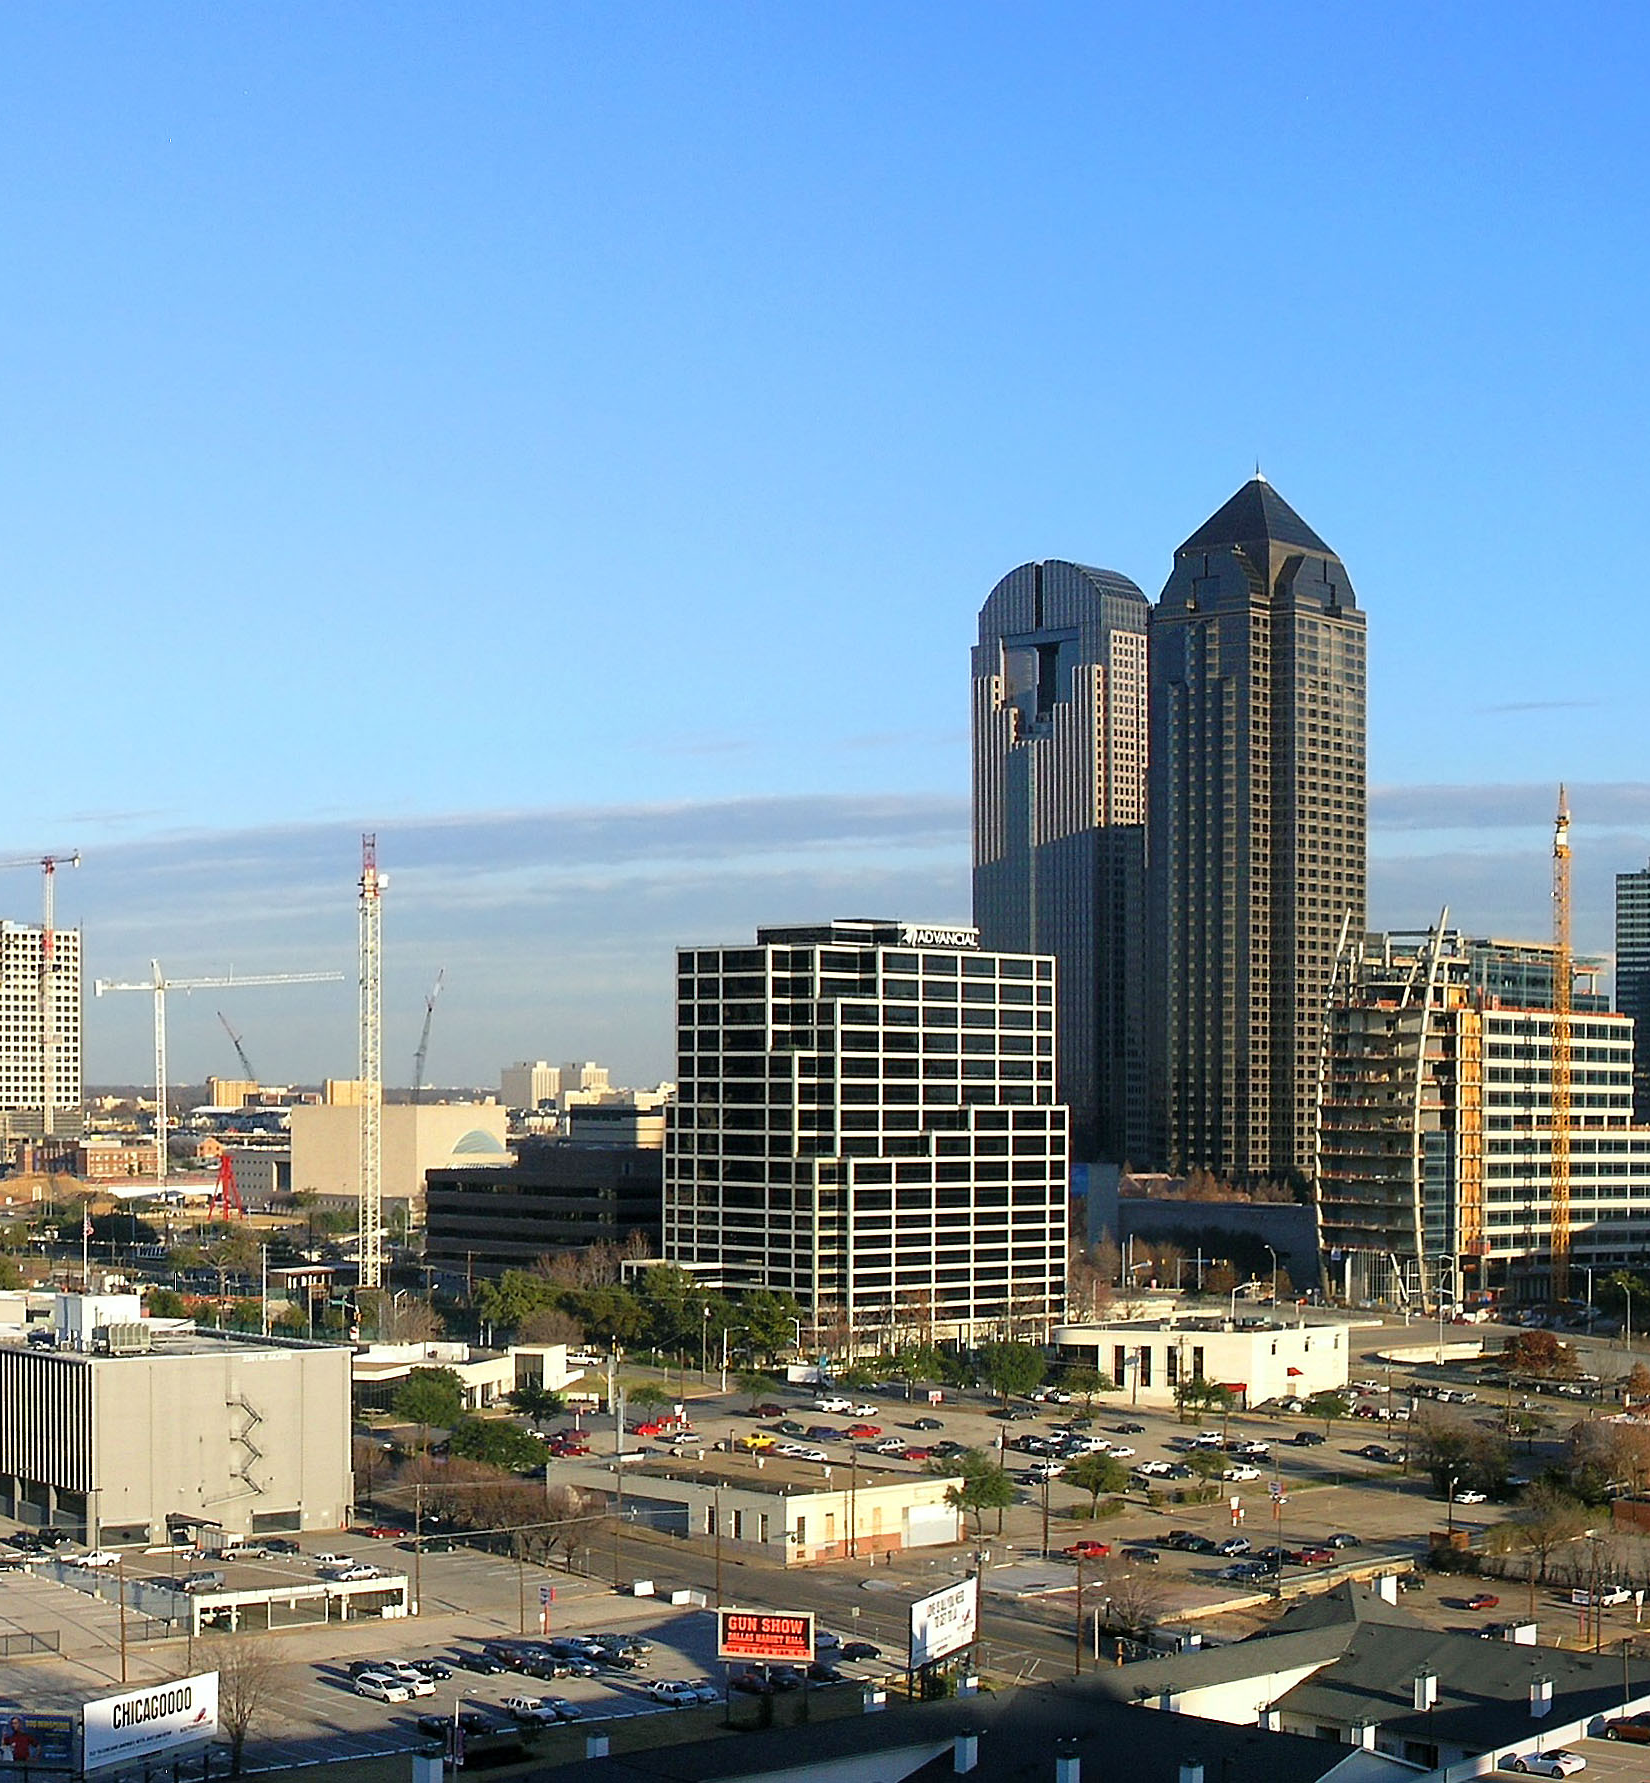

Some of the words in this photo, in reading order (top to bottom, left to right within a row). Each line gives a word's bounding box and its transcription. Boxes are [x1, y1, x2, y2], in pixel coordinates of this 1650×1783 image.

[728, 1615, 758, 1631] GUN
[761, 1618, 804, 1634] SHOW
[113, 1686, 192, 1730] CHICAGOOOO
